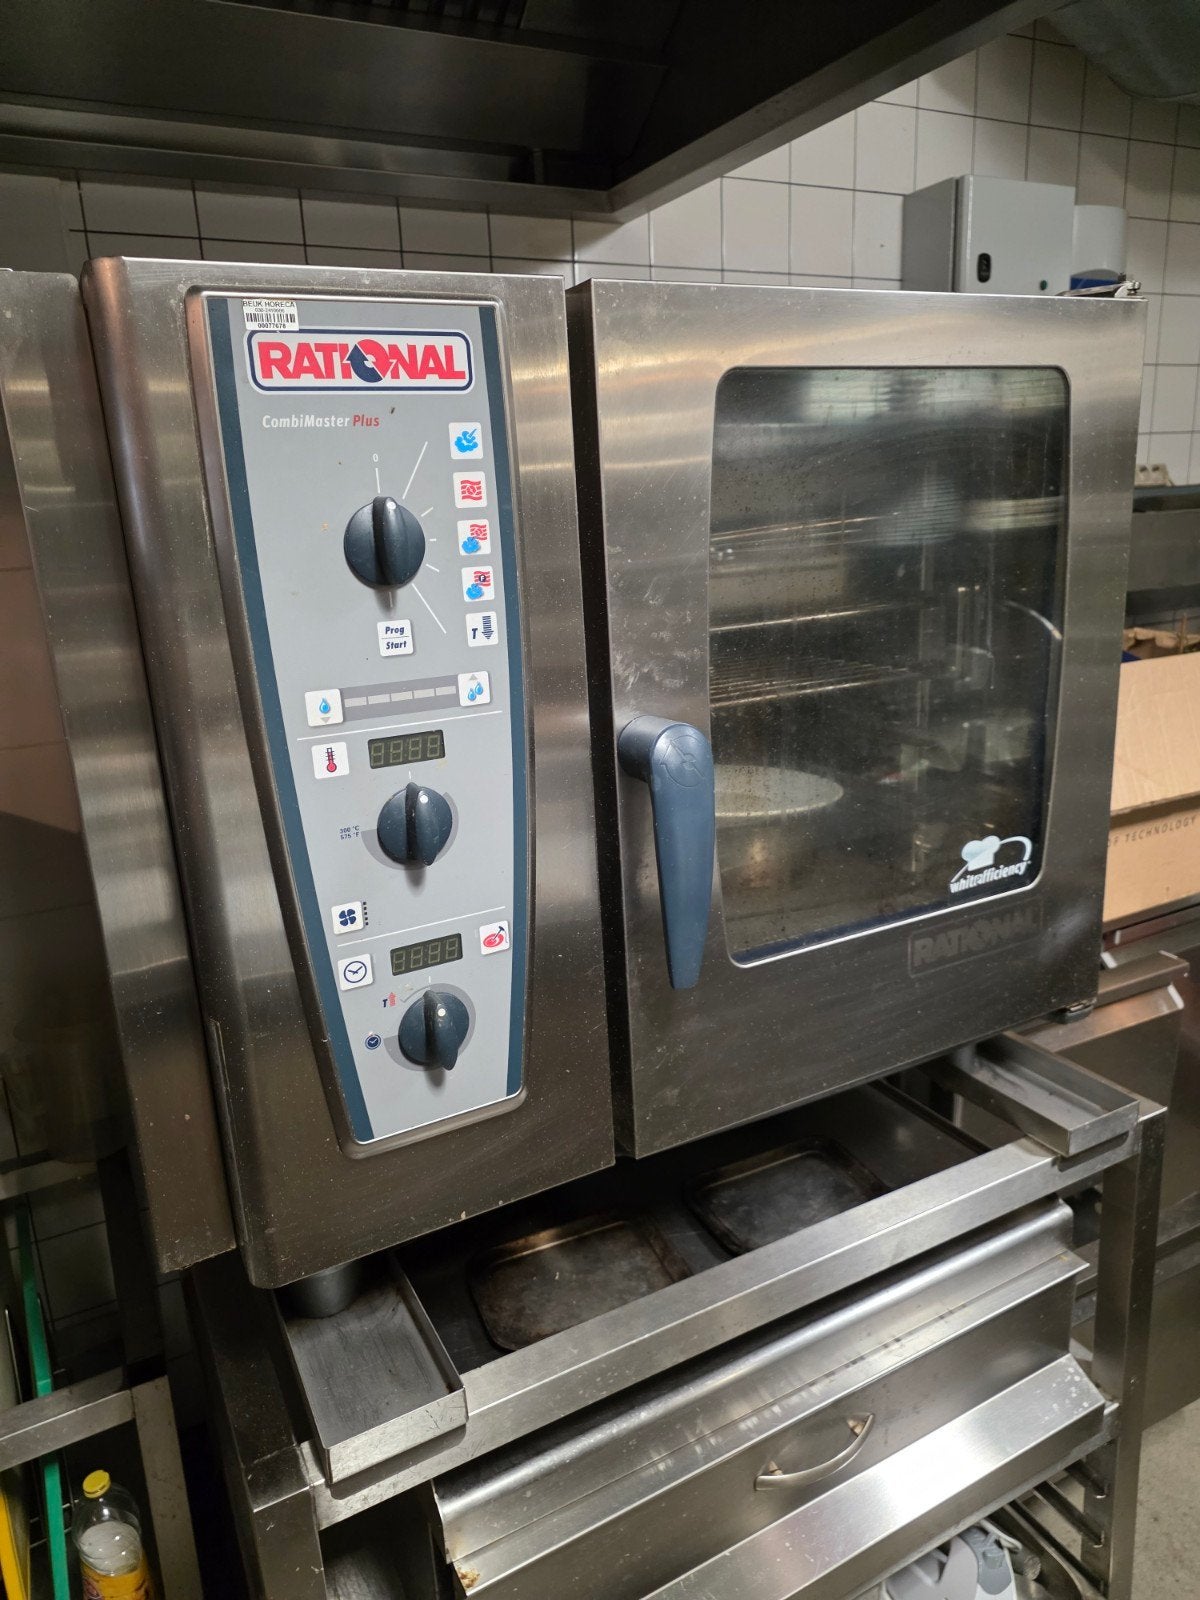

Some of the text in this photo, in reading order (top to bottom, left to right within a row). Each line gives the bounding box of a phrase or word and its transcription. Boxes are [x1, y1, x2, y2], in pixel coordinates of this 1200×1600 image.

[257, 338, 466, 384] RATIONAL
[261, 414, 380, 428] CombiMaster Plus
[385, 626, 405, 636] Prog
[471, 627, 479, 640] T
[385, 640, 407, 650] Start
[1125, 814, 1198, 842] TECHNOLOGY
[913, 904, 1038, 967] RATIONAL
